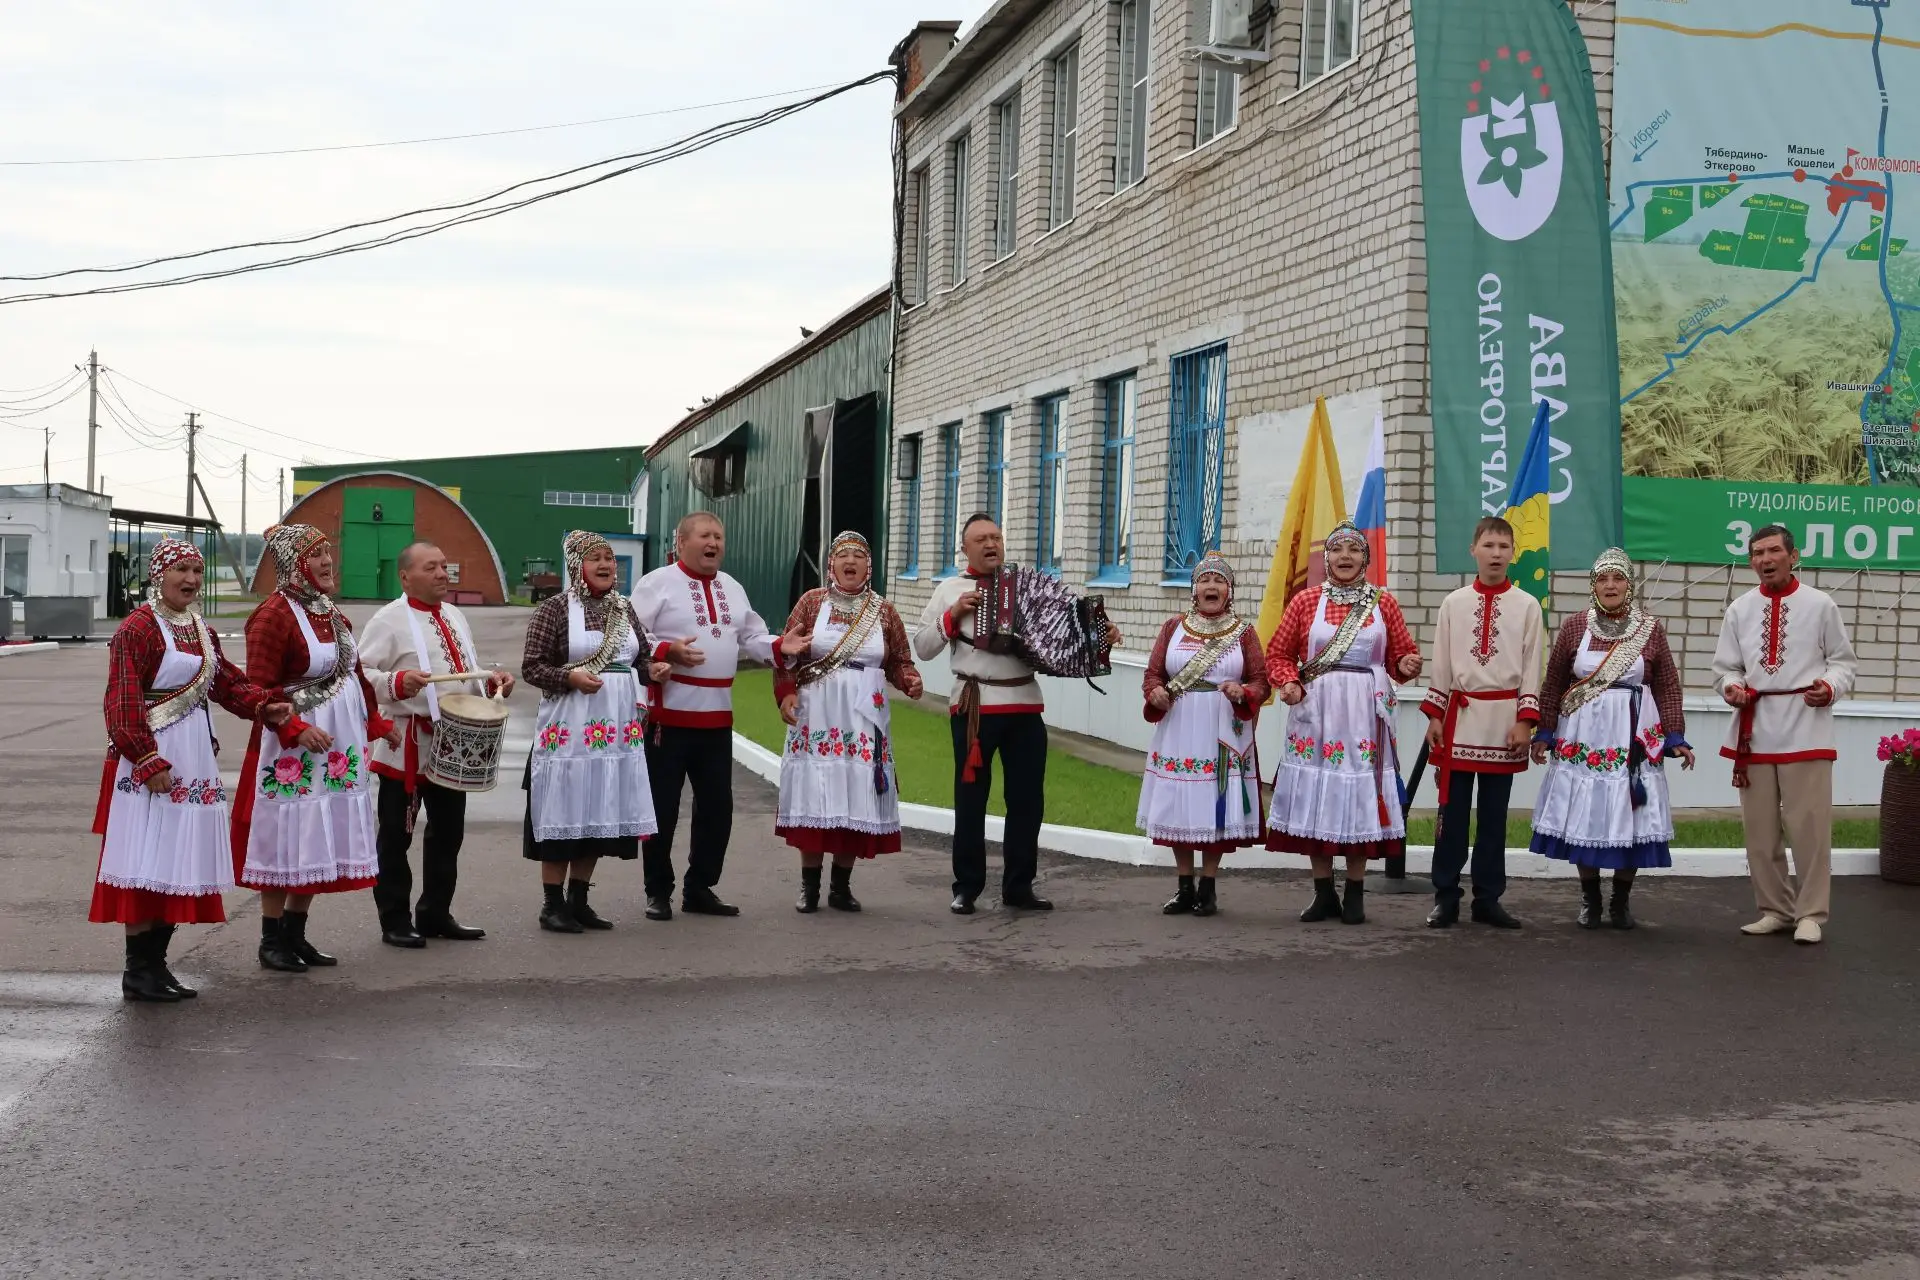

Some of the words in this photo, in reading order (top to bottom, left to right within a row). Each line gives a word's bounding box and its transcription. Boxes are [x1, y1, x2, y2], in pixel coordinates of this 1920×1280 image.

[1629, 109, 1672, 150] Ибреси
[1705, 147, 1767, 160] Тябердино-
[1788, 145, 1825, 156] Малые
[1704, 161, 1756, 172] Эткерово
[1788, 158, 1835, 169] Кошелеи
[1679, 294, 1730, 333] Саранск
[1827, 380, 1882, 392] Ивашкино
[1862, 435, 1918, 447] Шихазаны
[1727, 491, 1856, 515] ТРУДОЛЮБИЕ,
[1725, 520, 1914, 560] ЗЛОГ
